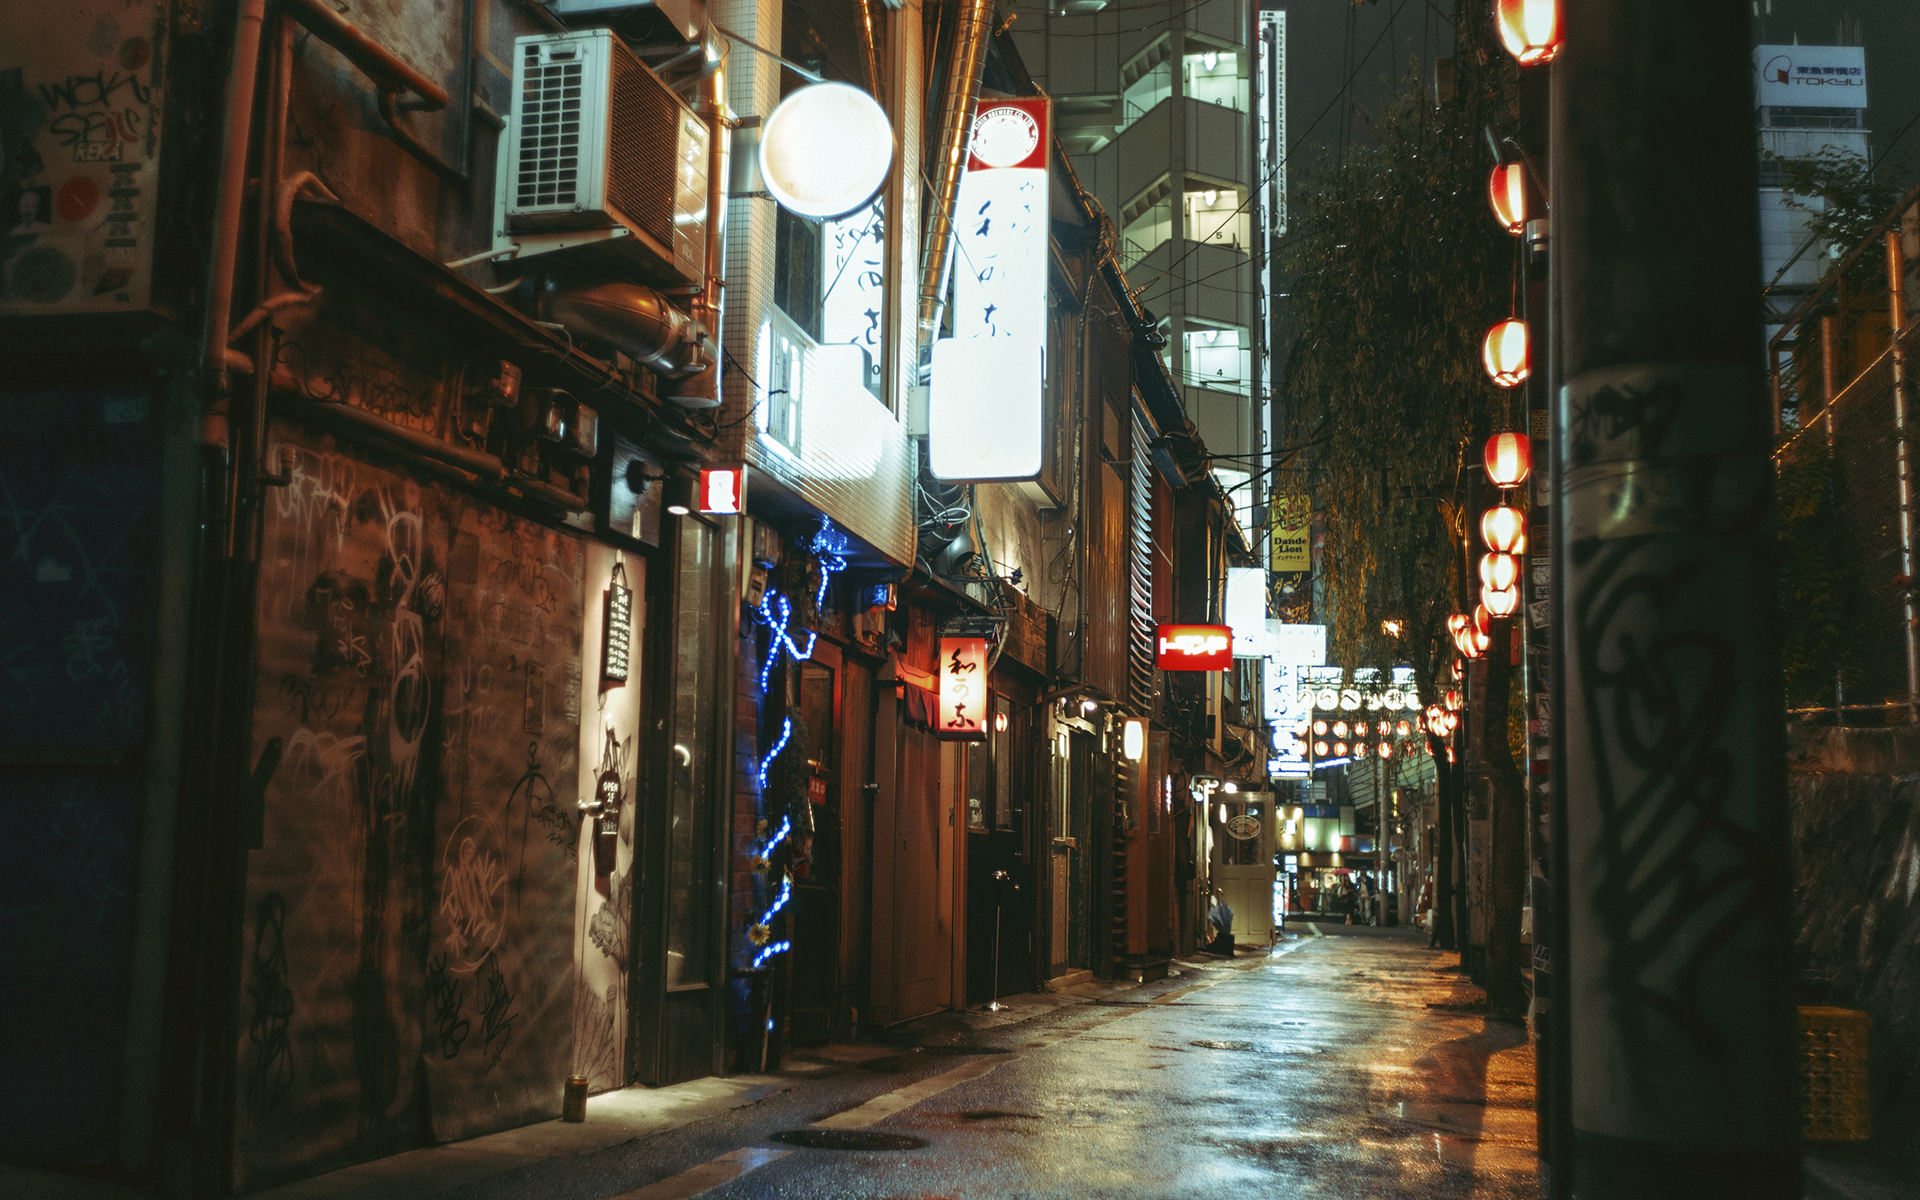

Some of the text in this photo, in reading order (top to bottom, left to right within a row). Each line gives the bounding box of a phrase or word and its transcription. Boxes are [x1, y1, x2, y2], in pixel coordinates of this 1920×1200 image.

[1796, 66, 1861, 76] 東急東横店
[1790, 76, 1864, 87] TOKYU
[1215, 231, 1223, 240] 5
[1216, 368, 1223, 377] 4
[1274, 537, 1306, 545] Dande
[1279, 545, 1303, 553] Lion
[603, 782, 619, 792] OPEN
